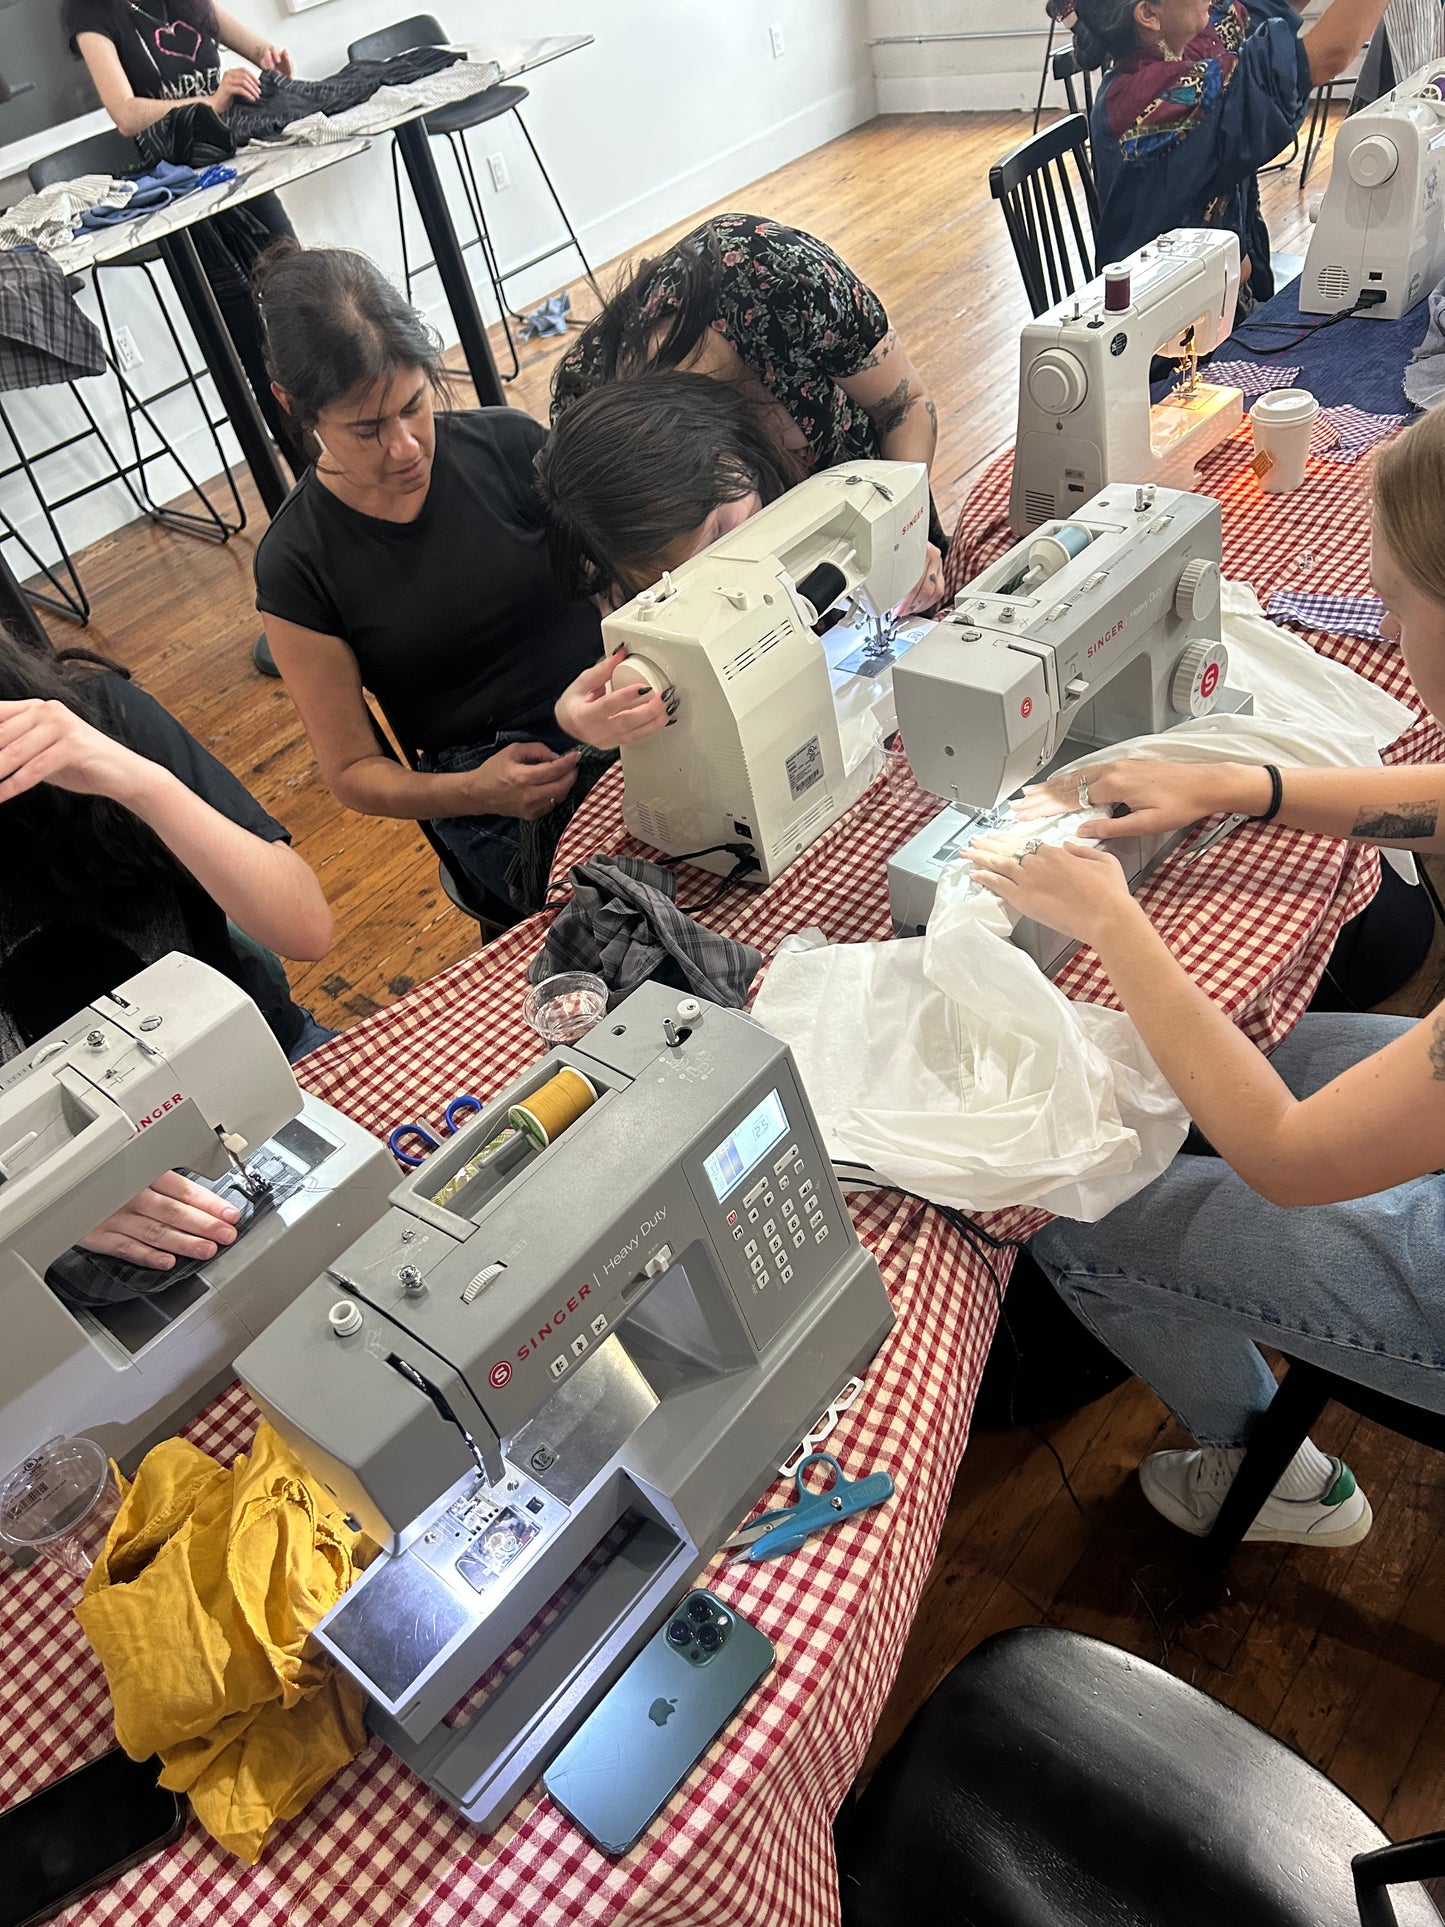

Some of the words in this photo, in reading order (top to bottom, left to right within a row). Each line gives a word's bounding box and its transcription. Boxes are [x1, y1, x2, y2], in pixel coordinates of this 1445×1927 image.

[1087, 620, 1124, 658] SINGER
[766, 1224, 773, 1234] 2
[785, 1204, 791, 1213] 3
[773, 1239, 779, 1249] 5
[791, 1219, 797, 1228] 6
[516, 1284, 592, 1361] SINGER
[602, 1234, 640, 1275] Heavy
[640, 1206, 668, 1237] Duty
[760, 1275, 766, 1284] 7
